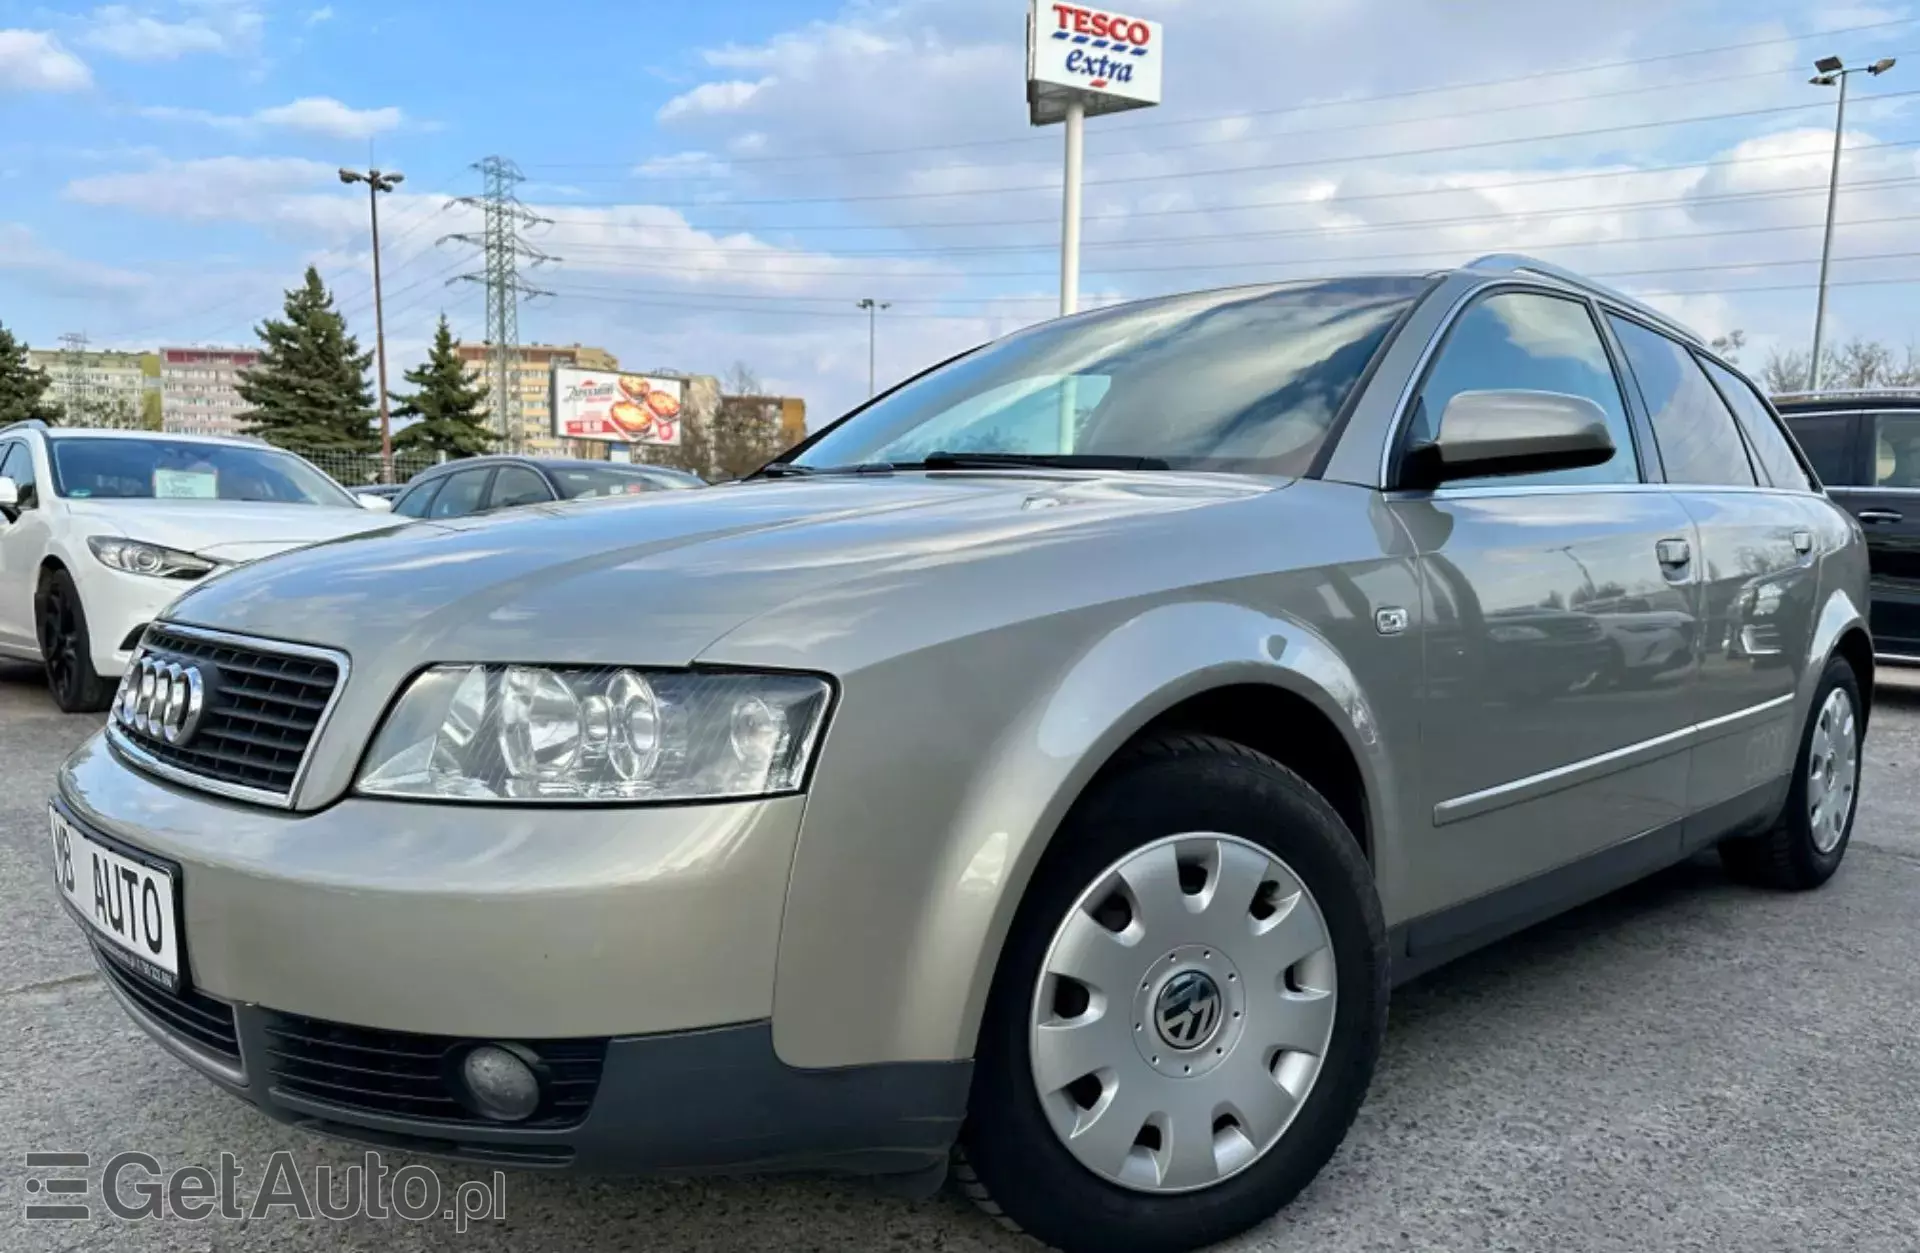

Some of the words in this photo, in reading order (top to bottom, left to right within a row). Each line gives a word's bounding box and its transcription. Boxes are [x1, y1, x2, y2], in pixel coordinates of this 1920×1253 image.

[1052, 3, 1150, 46] TESCO
[1066, 48, 1134, 83] extra
[92, 852, 163, 955] AUTO
